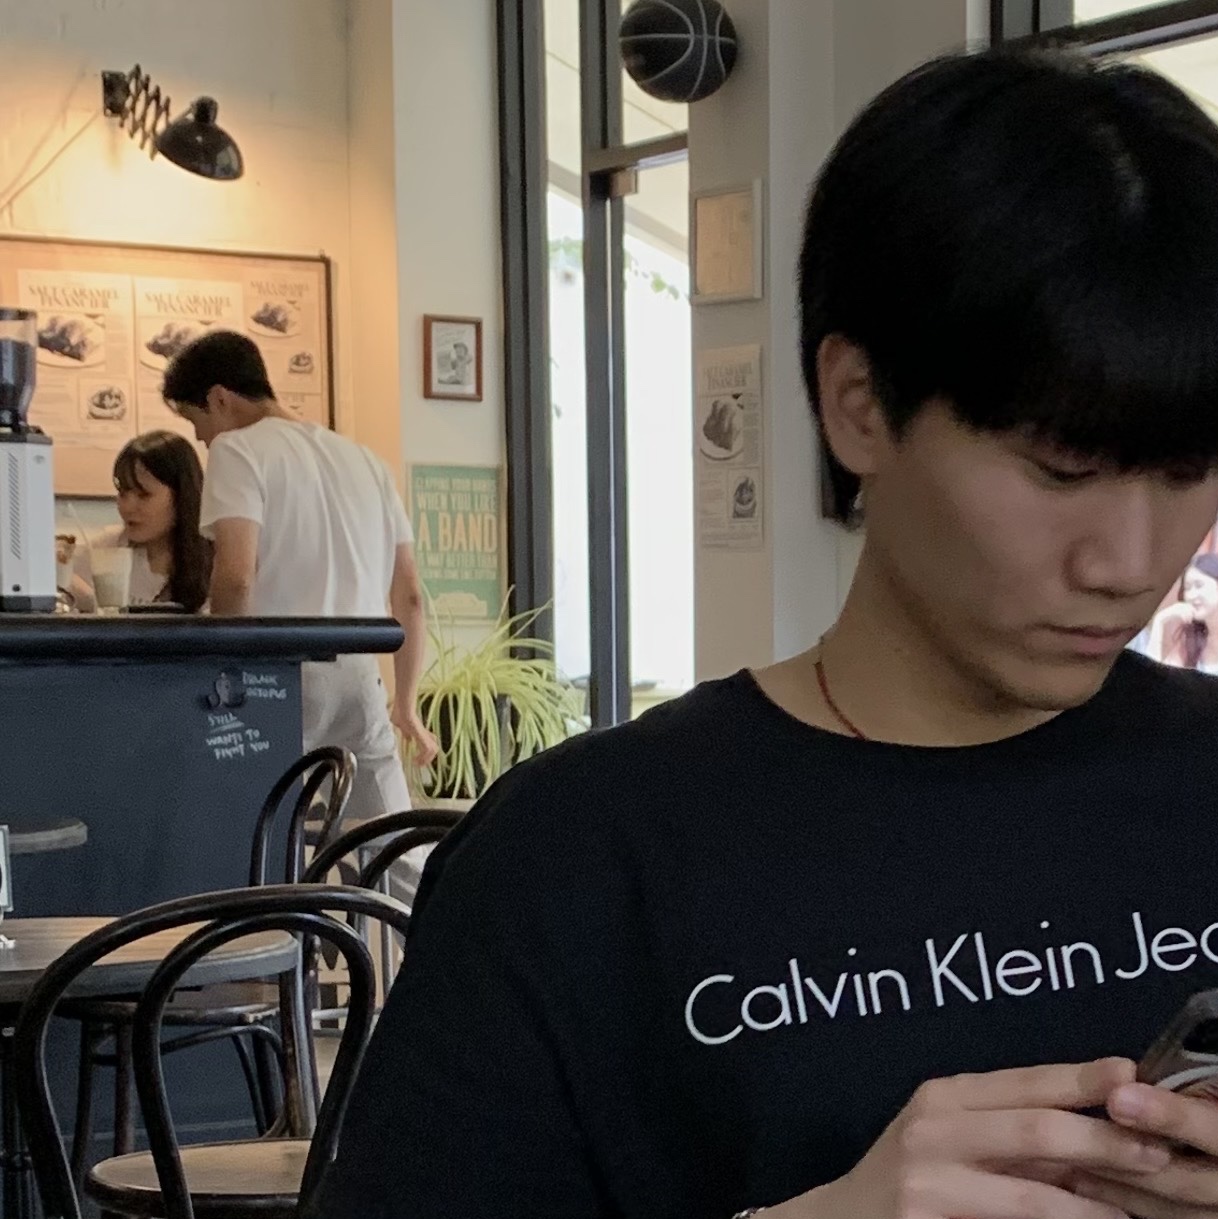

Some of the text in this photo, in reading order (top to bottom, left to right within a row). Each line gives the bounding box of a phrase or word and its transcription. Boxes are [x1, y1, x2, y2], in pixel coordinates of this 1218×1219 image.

[416, 491, 497, 513] WHEN YOU LIKE
[417, 511, 498, 553] A BAND
[207, 711, 238, 727] STILL
[245, 728, 260, 740] TO
[250, 740, 270, 752] YOU
[686, 948, 910, 1044] Calvin
[926, 921, 1104, 1006] Klein
